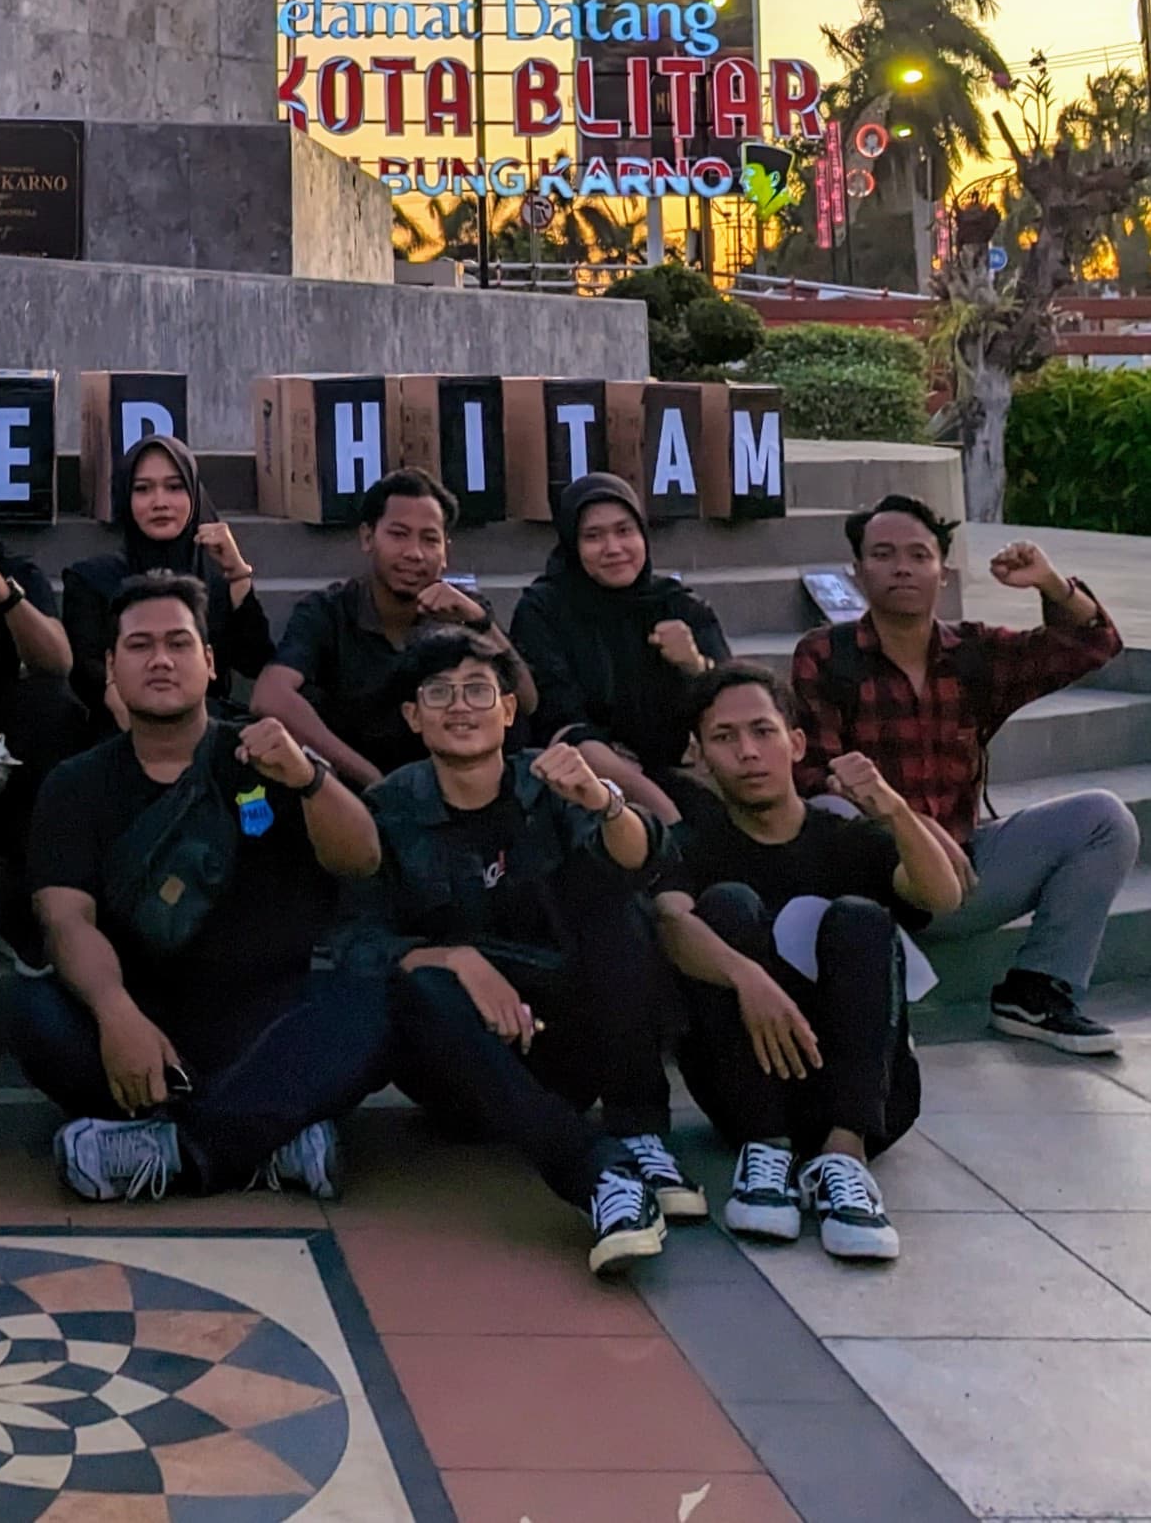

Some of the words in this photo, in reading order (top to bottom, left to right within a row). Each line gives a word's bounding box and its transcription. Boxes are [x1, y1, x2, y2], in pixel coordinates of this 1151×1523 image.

[513, 56, 824, 140] BLITAR
[1, 175, 68, 192] KARNO
[379, 157, 527, 197] BUNG
[539, 156, 734, 198] KARNO
[334, 401, 781, 496] HITAM
